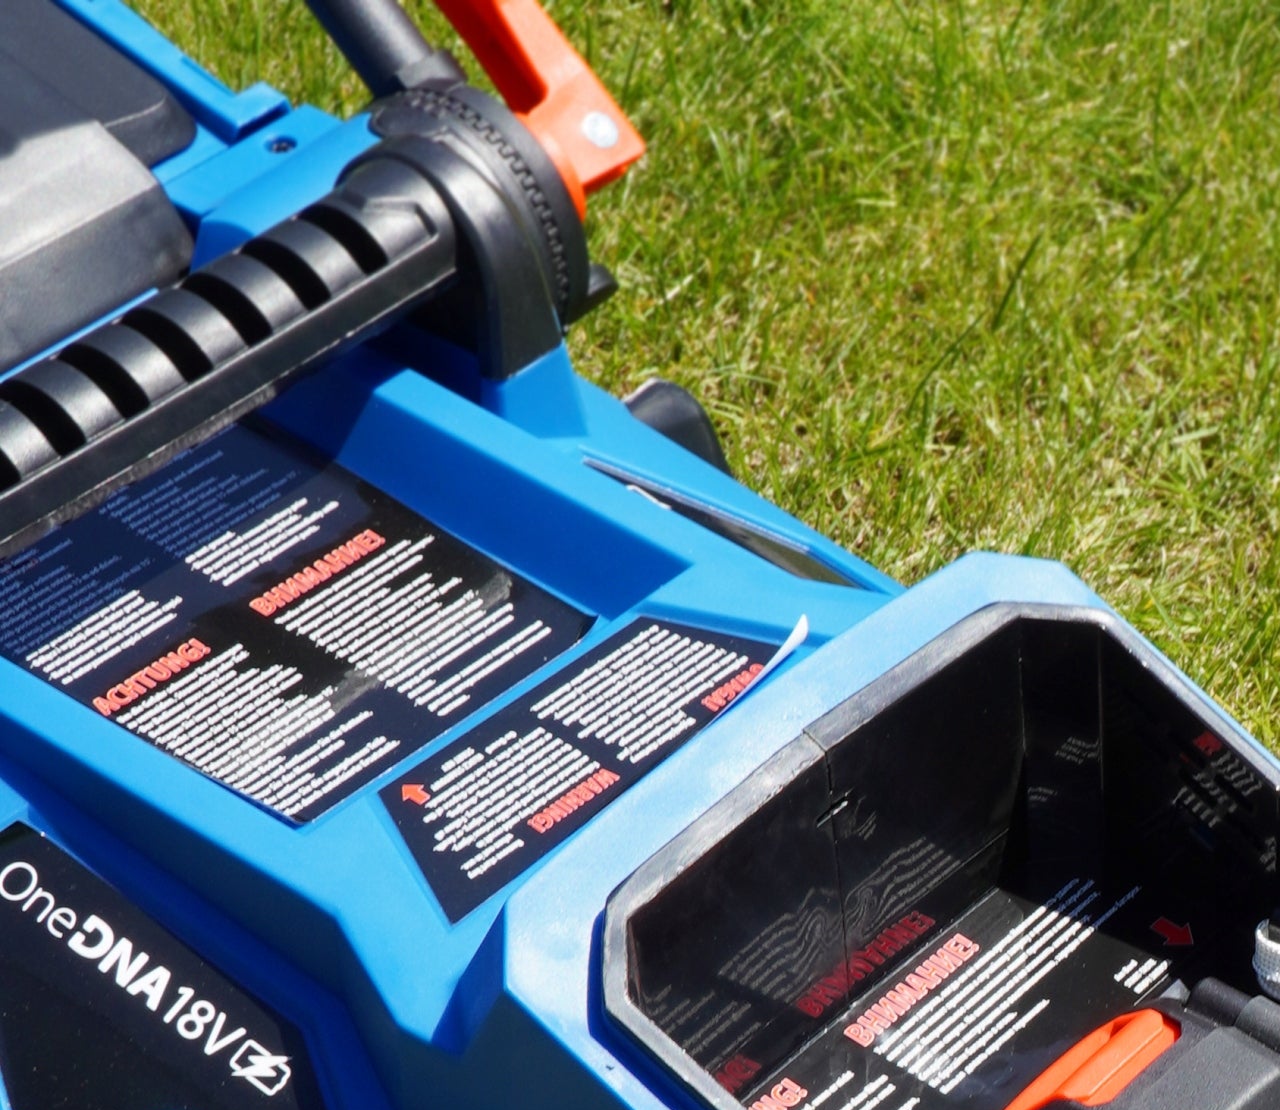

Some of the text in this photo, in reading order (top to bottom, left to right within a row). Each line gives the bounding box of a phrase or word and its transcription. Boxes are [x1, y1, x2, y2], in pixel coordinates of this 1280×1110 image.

[249, 529, 386, 617] ВНИМАНИЕ!
[93, 638, 211, 716] ACHTUNG!
[527, 768, 620, 833] WARNING!
[843, 933, 981, 1047] ВНИМАНИЕ!
